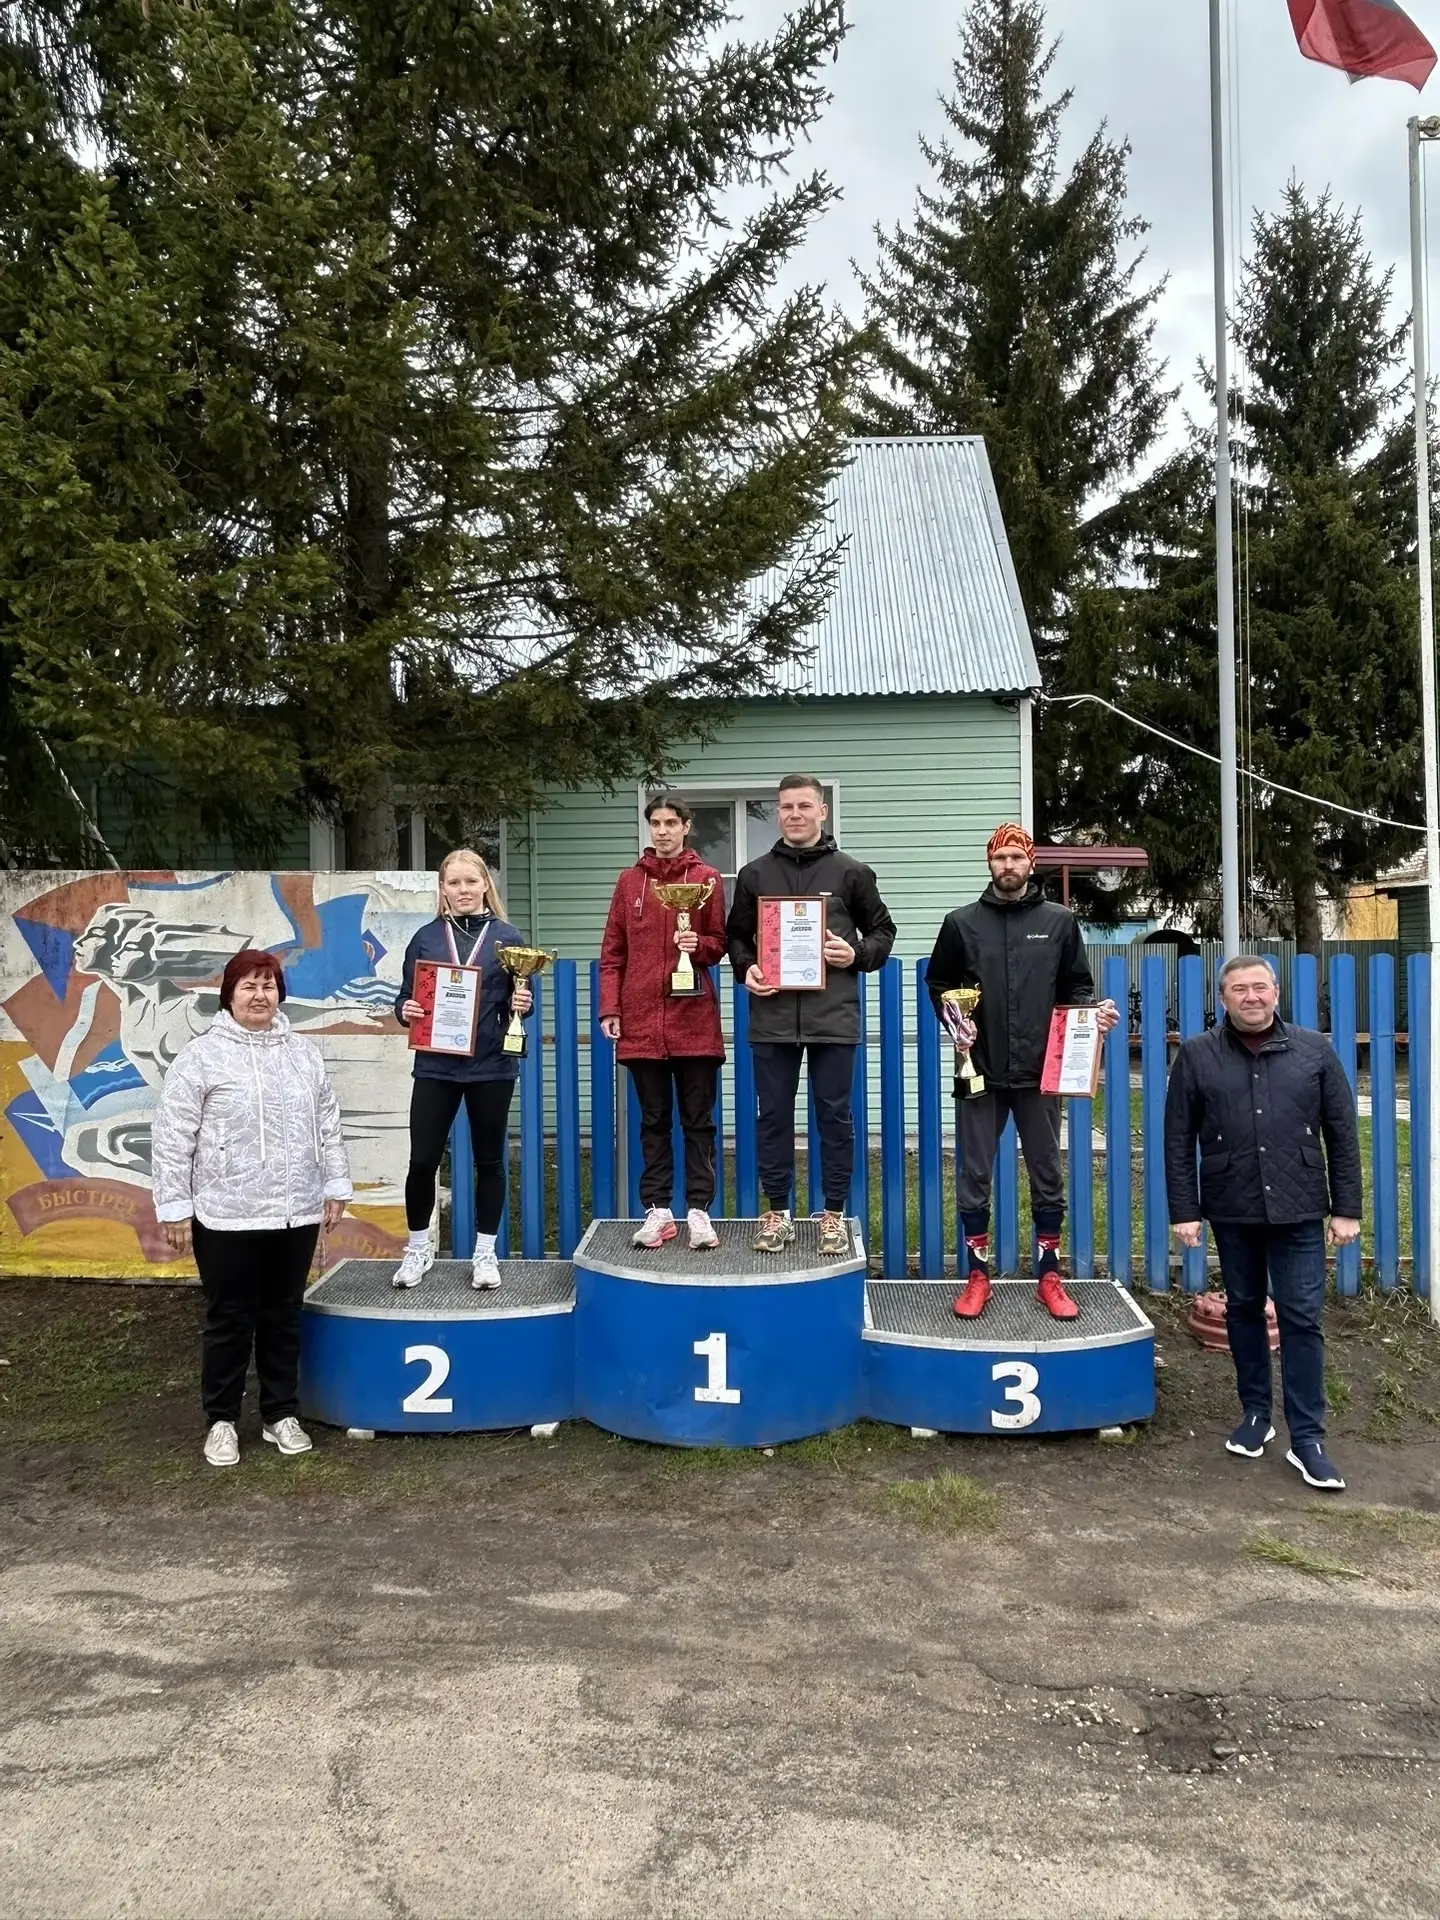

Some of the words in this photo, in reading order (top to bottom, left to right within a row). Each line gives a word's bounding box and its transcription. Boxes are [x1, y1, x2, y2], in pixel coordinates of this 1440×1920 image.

[403, 1345, 453, 1412] 2
[694, 1333, 740, 1404] 1
[991, 1361, 1041, 1429] 3
